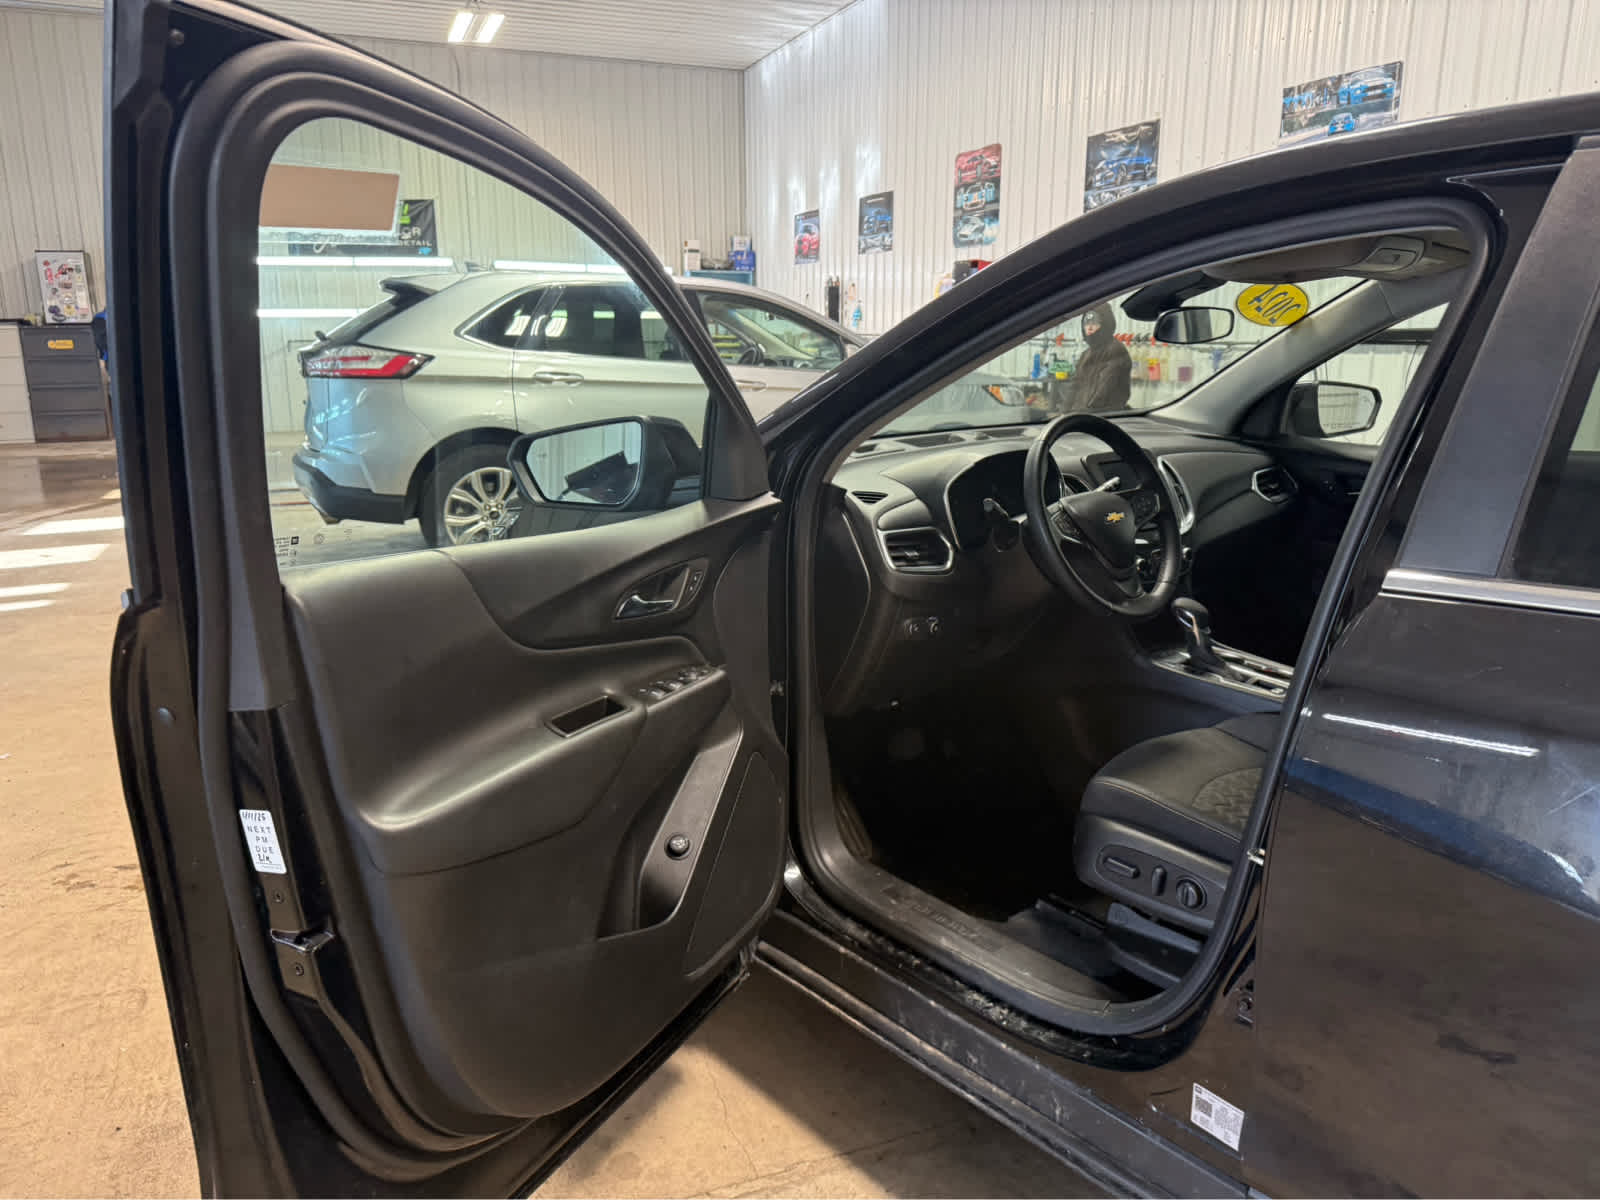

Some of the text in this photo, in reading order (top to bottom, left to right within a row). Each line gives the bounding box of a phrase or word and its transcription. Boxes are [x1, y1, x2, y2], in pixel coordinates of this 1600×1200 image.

[247, 825, 272, 834] NEXT
[255, 835, 268, 843] PM
[255, 845, 274, 854] DUE
